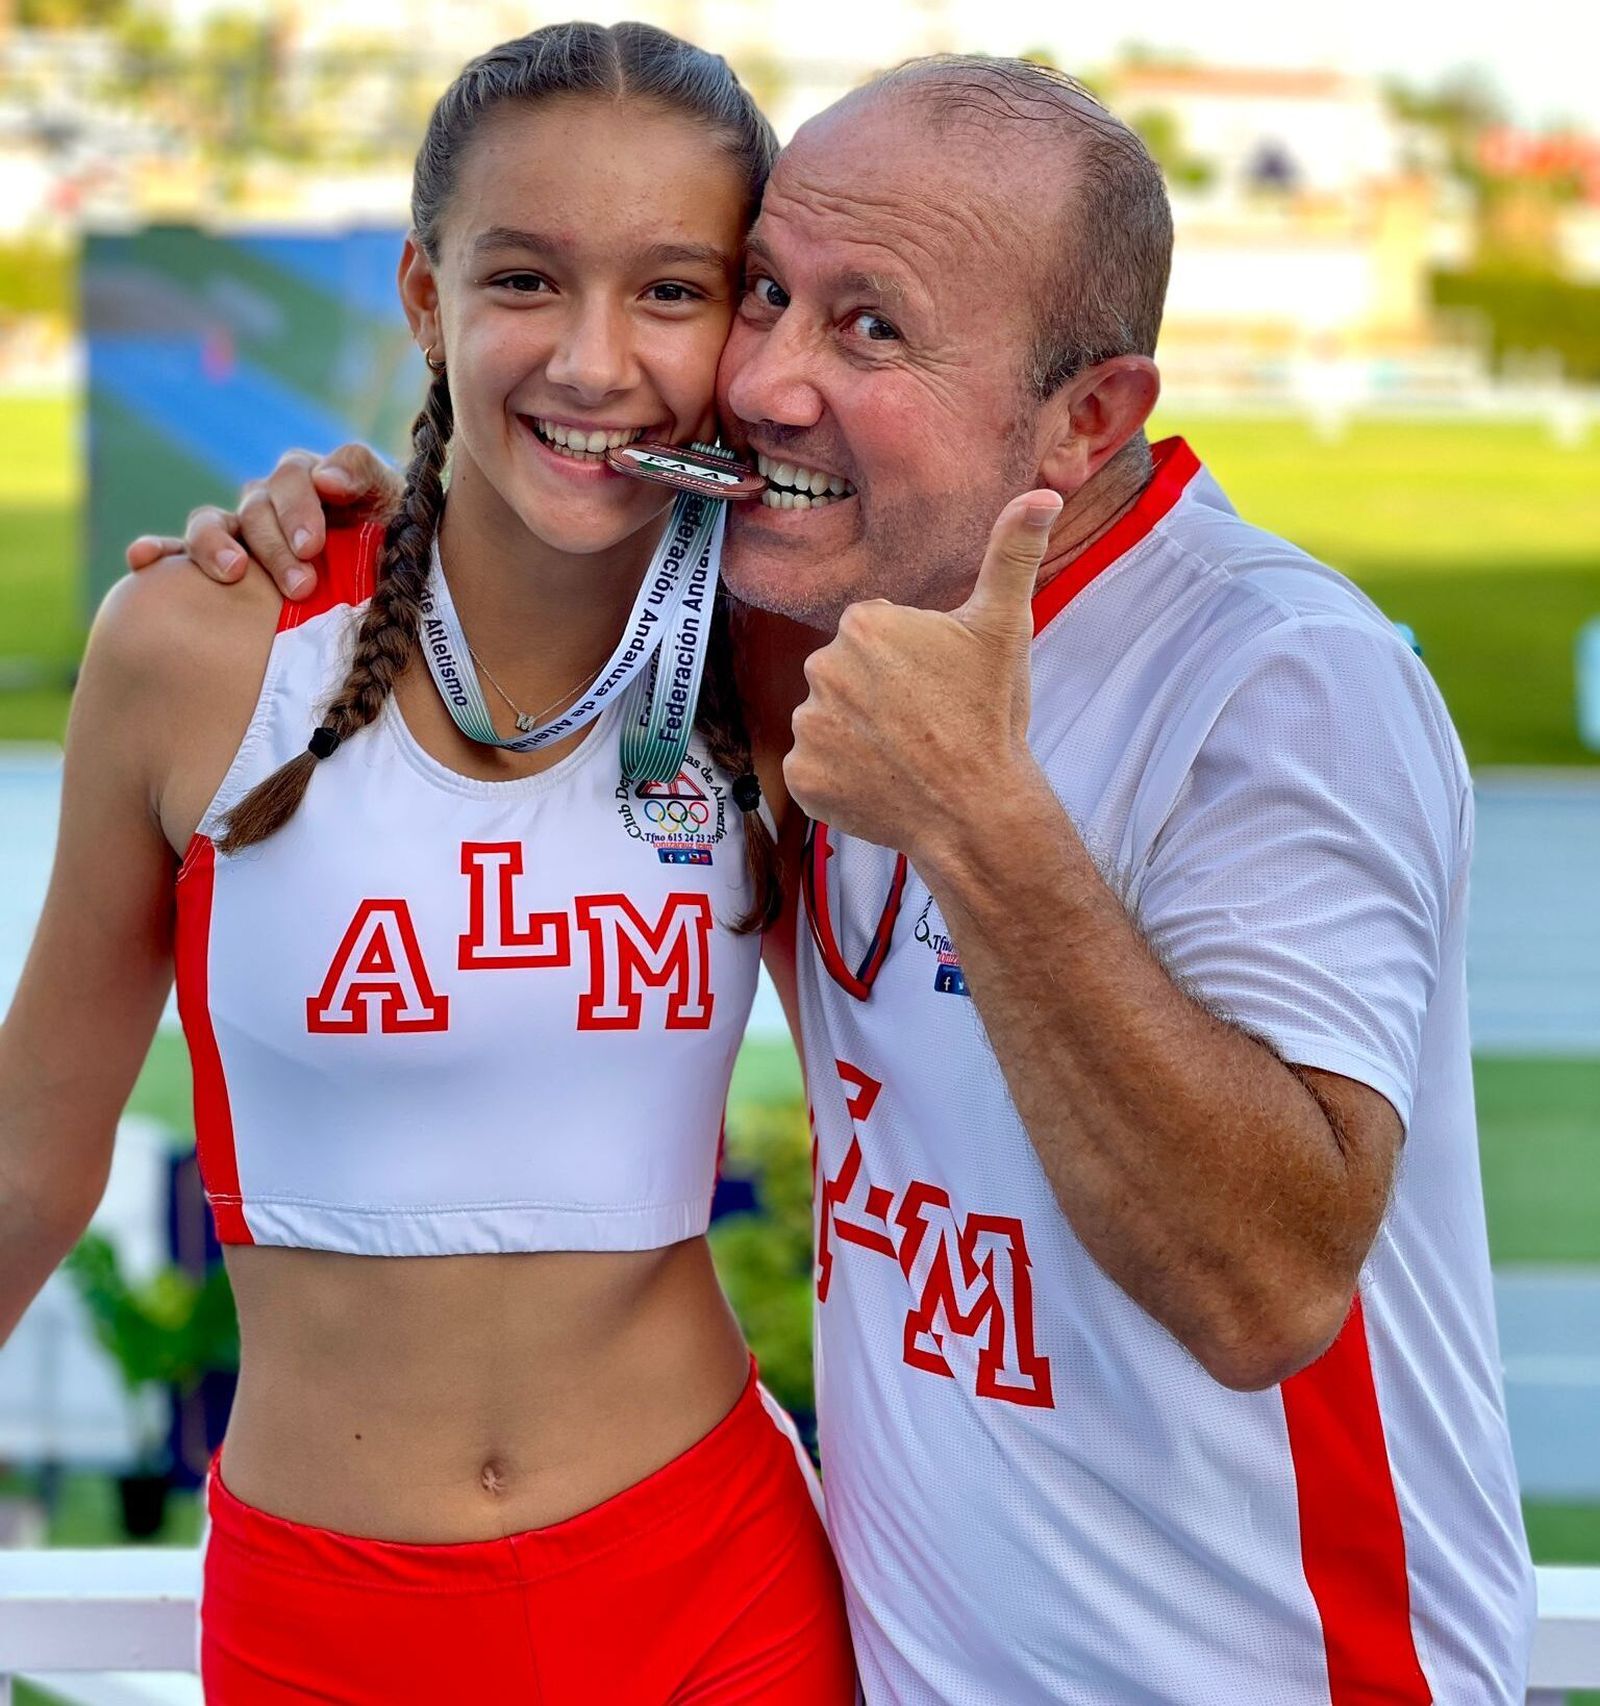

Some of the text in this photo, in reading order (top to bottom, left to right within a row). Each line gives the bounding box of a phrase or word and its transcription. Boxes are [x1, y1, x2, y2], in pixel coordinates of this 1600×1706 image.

[648, 499, 704, 605] ederación
[424, 619, 468, 707] Atletismo
[594, 608, 659, 697] Andaluza
[659, 618, 699, 742] Federación
[571, 700, 596, 717] de
[701, 766, 714, 784] de
[644, 833, 666, 844] Tfno
[668, 833, 682, 841] 615
[685, 834, 695, 842] 24
[697, 834, 705, 842] 23
[306, 841, 715, 1034] ALM
